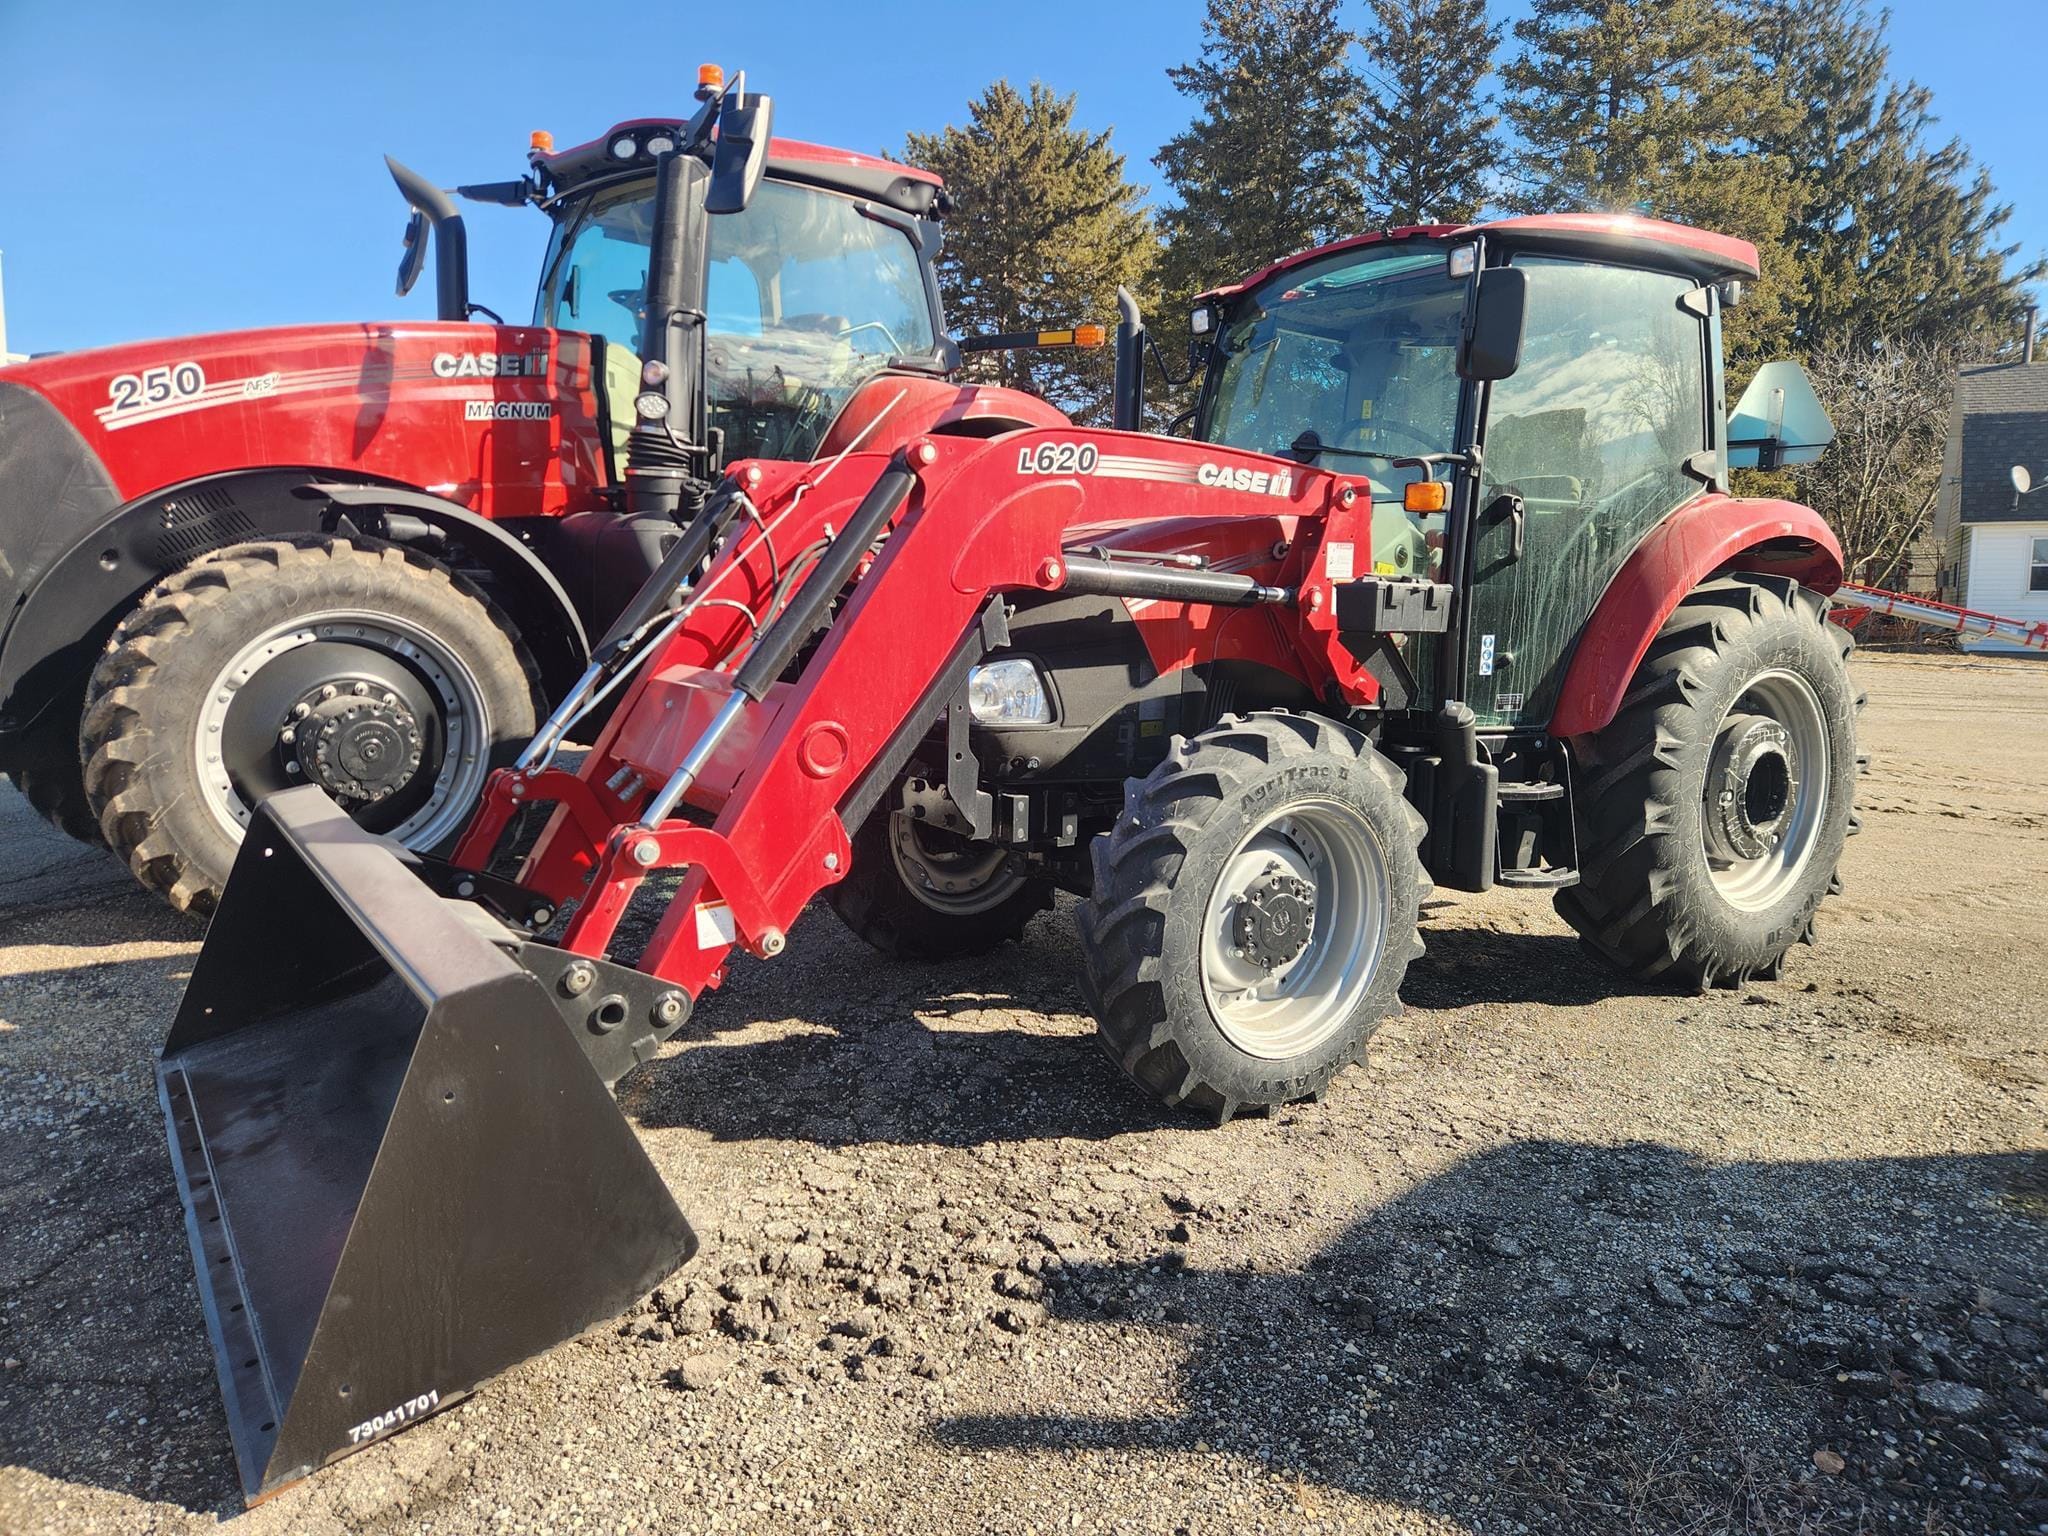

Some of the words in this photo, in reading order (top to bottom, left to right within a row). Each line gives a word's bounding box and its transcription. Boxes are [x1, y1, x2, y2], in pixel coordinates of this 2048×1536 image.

[431, 352, 519, 378] CASE
[111, 363, 204, 412] 250
[466, 402, 551, 419] MAGNUM
[1018, 444, 1098, 474] L620
[1198, 463, 1269, 494] CASE
[1240, 766, 1330, 811] AgriTrac
[1256, 1040, 1356, 1093] GALAXY
[347, 1388, 440, 1444] 73041701
